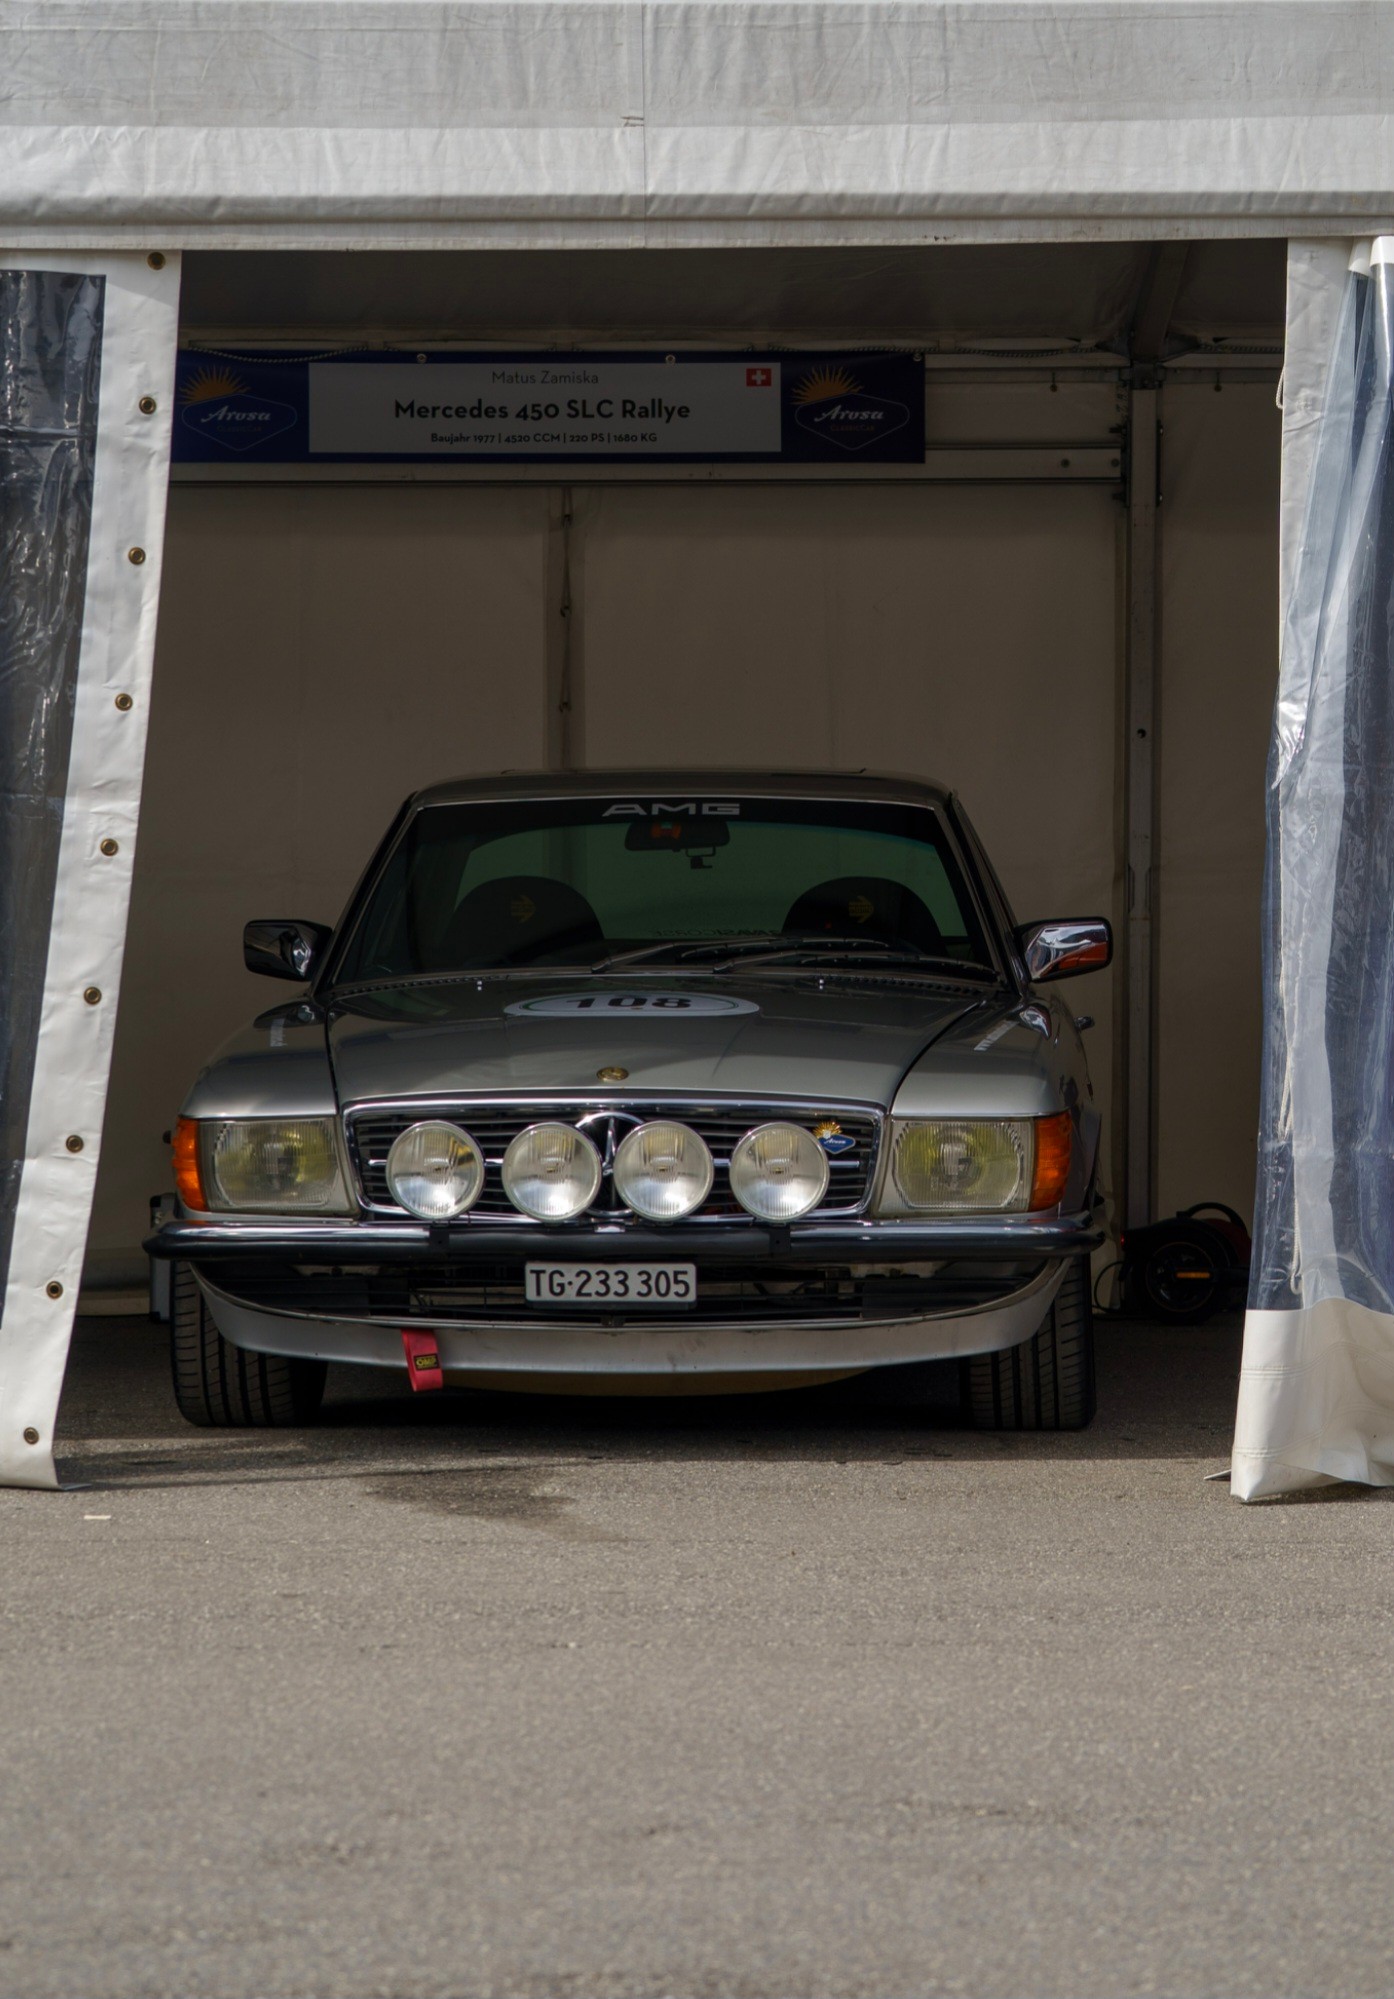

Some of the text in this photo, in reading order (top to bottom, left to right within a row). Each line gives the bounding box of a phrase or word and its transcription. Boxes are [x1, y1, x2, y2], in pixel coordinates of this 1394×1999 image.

[492, 369, 600, 384] Matus Zamiska
[200, 404, 272, 423] Arosa
[394, 398, 691, 424] Mercedes 450 SLC Rallye
[813, 403, 884, 422] Arosa
[430, 432, 471, 445] Baujahr
[473, 434, 496, 445] 1977
[504, 434, 531, 445] 4520
[533, 432, 561, 443] CCM
[569, 434, 589, 443] 220
[591, 432, 605, 443] PS
[613, 432, 638, 443] 1680
[640, 432, 658, 443] KG
[601, 802, 741, 817] AMG
[565, 997, 692, 1009] 108
[636, 1269, 691, 1299] 305
